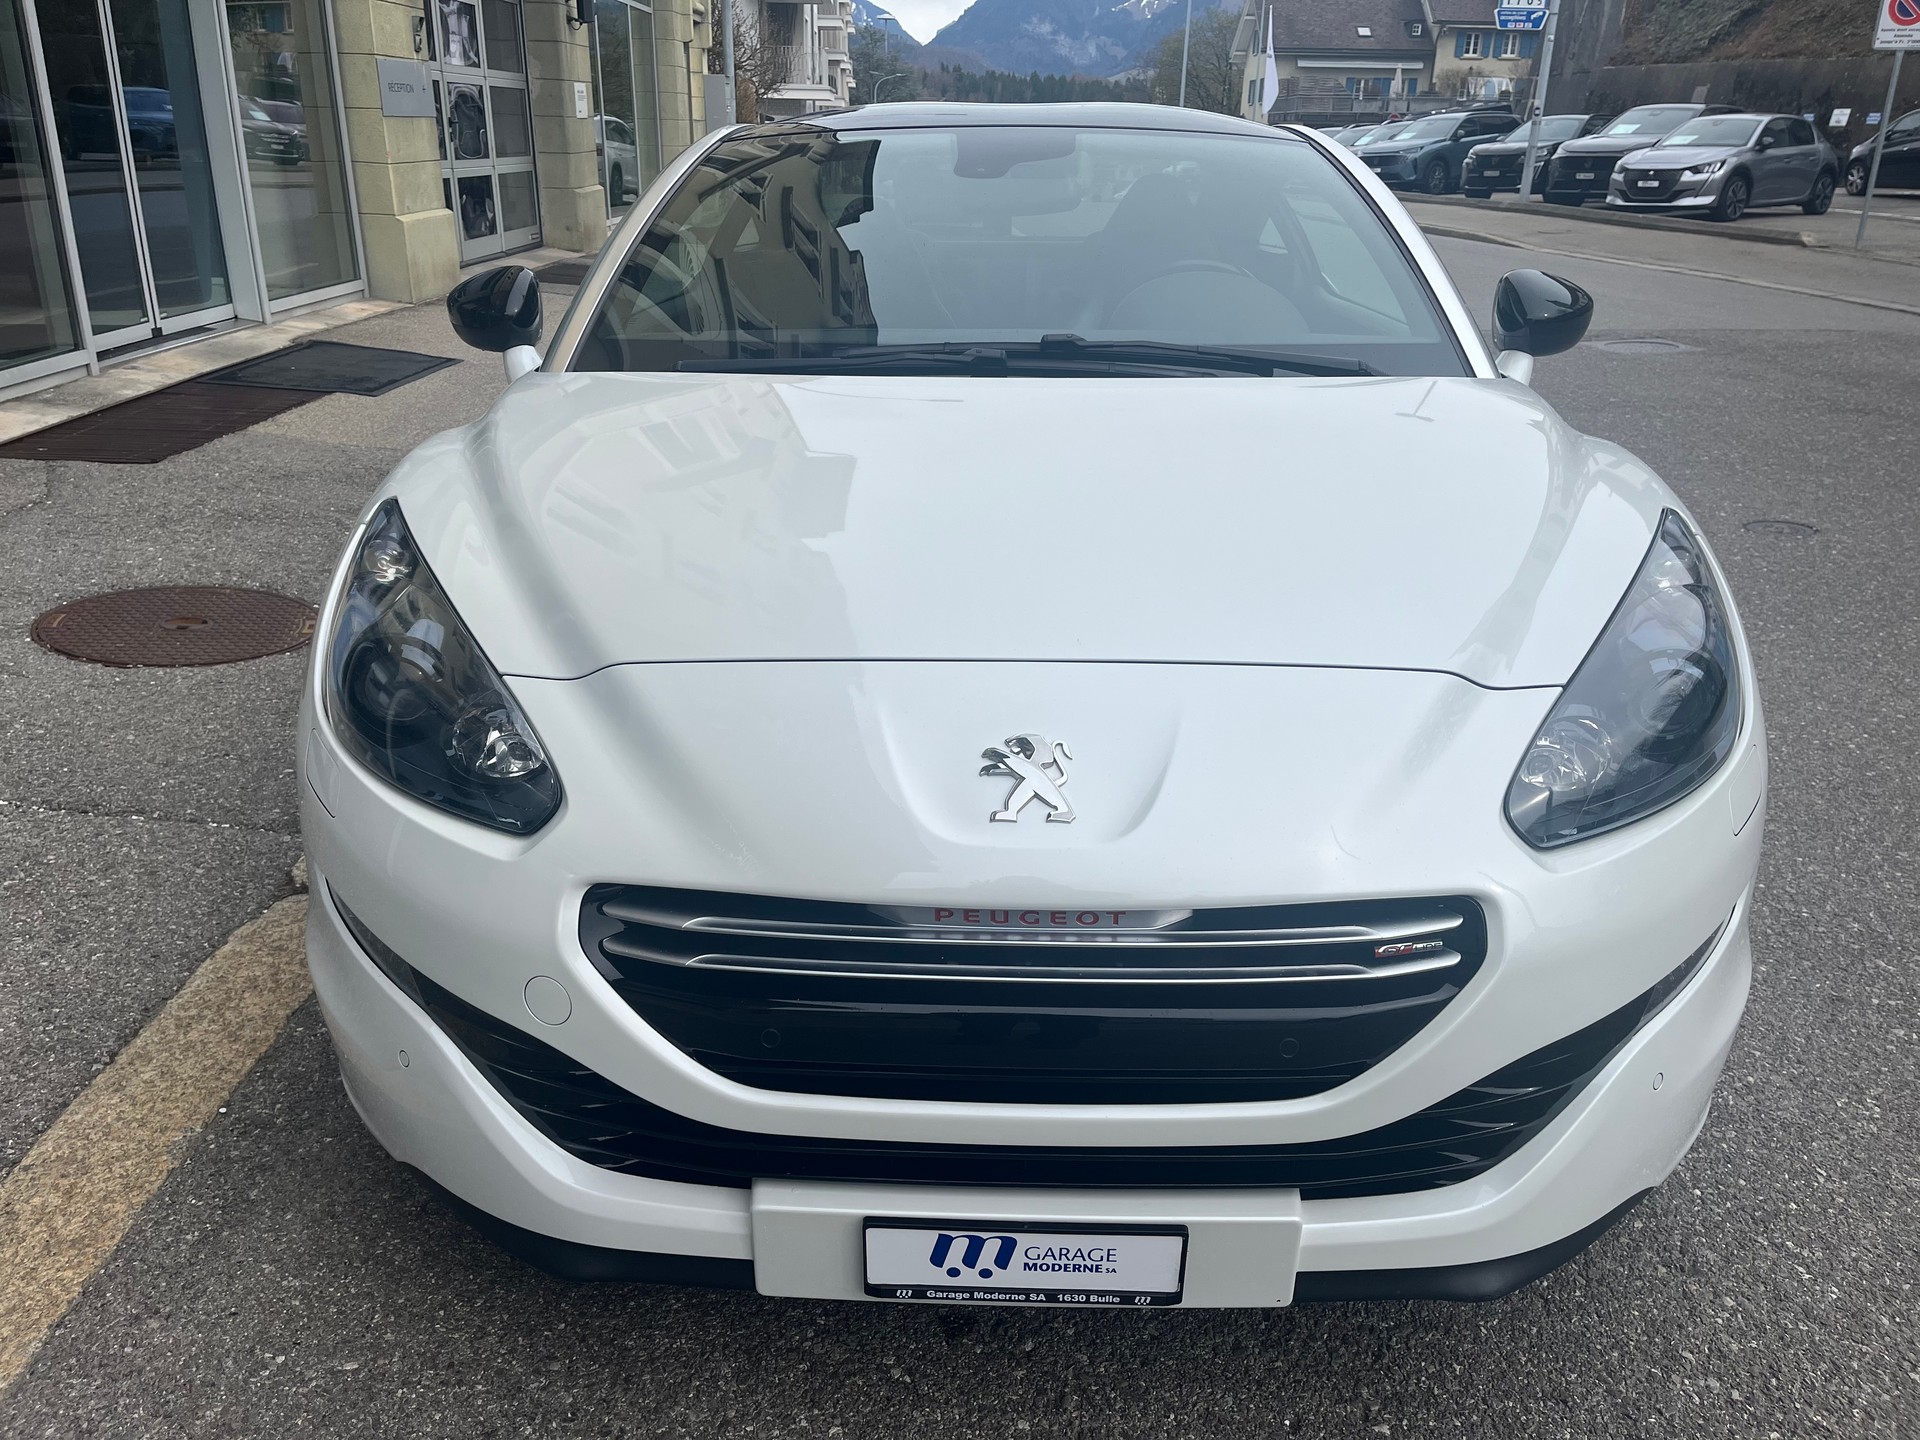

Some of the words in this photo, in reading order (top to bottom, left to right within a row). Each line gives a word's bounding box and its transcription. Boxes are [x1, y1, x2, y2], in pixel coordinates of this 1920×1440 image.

[934, 907, 1126, 926] PEUGEOT
[1024, 1246, 1118, 1263] GARAGE
[1023, 1262, 1103, 1274] MODERNE
[926, 1290, 971, 1300] Garage
[973, 1291, 1026, 1301] Moderne
[1029, 1293, 1047, 1301] SA
[1057, 1294, 1087, 1302] 1630
[1089, 1295, 1121, 1303] Bulle
